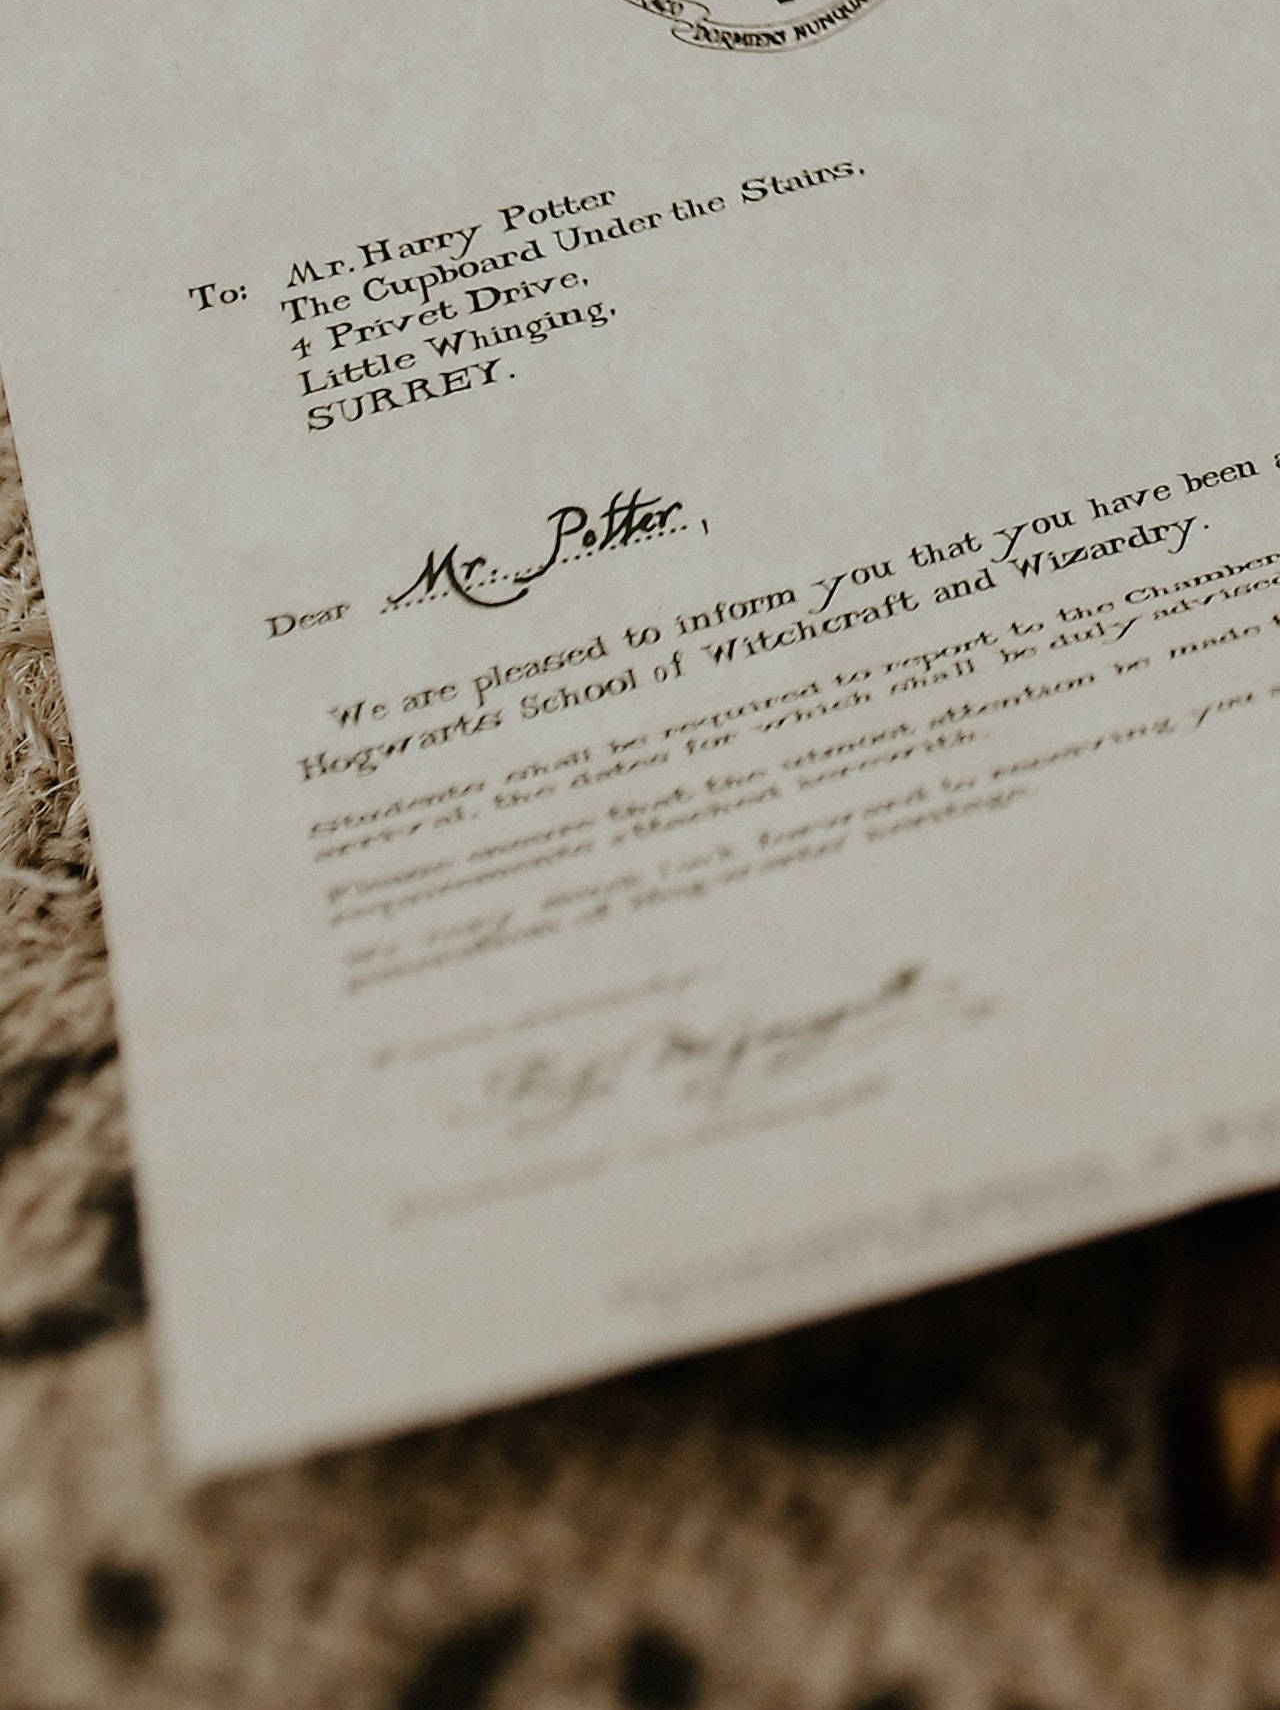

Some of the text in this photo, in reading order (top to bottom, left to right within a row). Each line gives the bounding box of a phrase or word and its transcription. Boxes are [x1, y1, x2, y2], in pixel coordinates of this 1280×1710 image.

[187, 189, 616, 311] To: Mr. Harry Potter
[279, 294, 351, 325] The
[362, 238, 546, 305] Cupboard
[552, 212, 663, 252] Under
[670, 196, 726, 223] the
[291, 336, 312, 361] 4
[325, 299, 459, 351] Privet
[298, 352, 417, 397] Little
[307, 357, 516, 432] SURREY.
[264, 602, 351, 639] Dear
[385, 543, 530, 611] Mr.
[330, 700, 386, 728] We
[401, 683, 458, 714] are
[471, 634, 609, 709] pleased
[623, 626, 662, 649] to
[675, 588, 797, 636] inform
[807, 560, 895, 615] you
[908, 531, 983, 568] that
[990, 510, 1075, 564] you
[1087, 484, 1172, 520] have
[1179, 460, 1260, 494] been
[298, 516, 1210, 782] Hogwarts School of Witchcraft and Wizardry.
